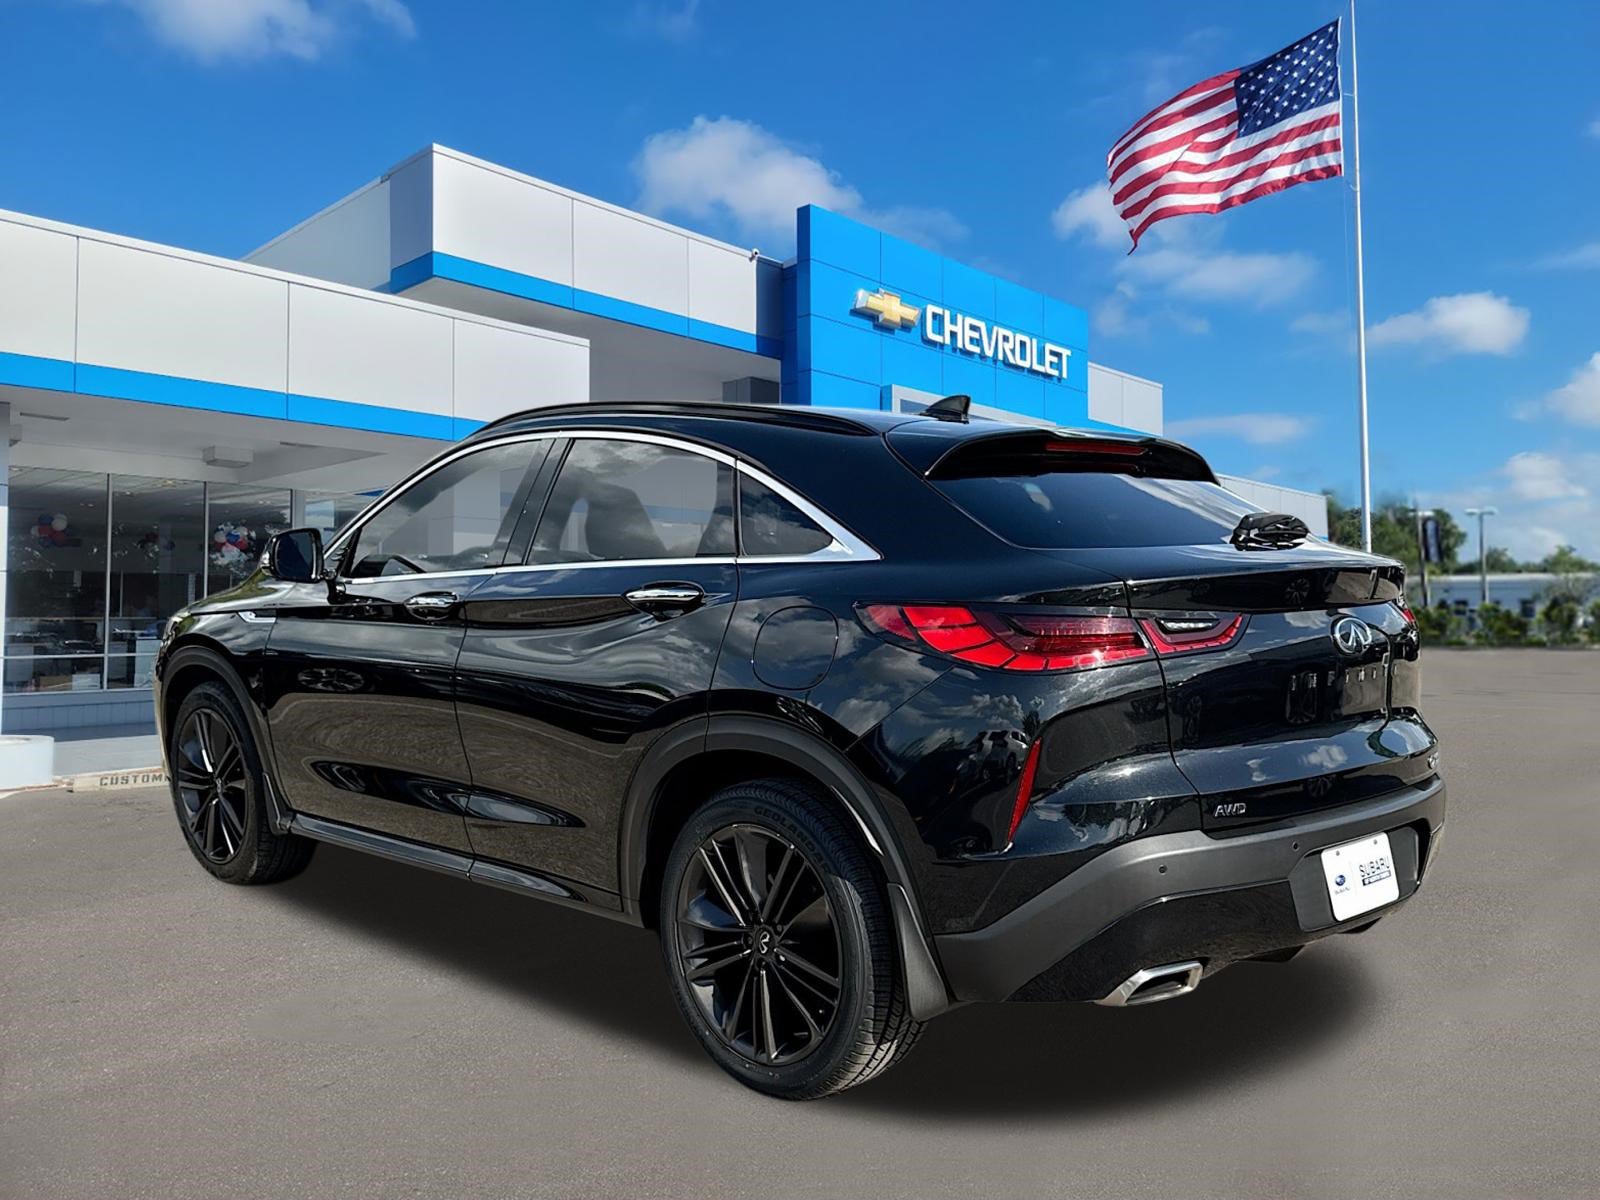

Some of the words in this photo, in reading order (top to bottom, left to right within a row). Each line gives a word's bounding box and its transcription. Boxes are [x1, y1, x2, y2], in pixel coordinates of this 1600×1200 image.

[925, 304, 1072, 379] CHEVROLET
[99, 772, 169, 787] CUSTOM
[1214, 802, 1247, 817] AWD
